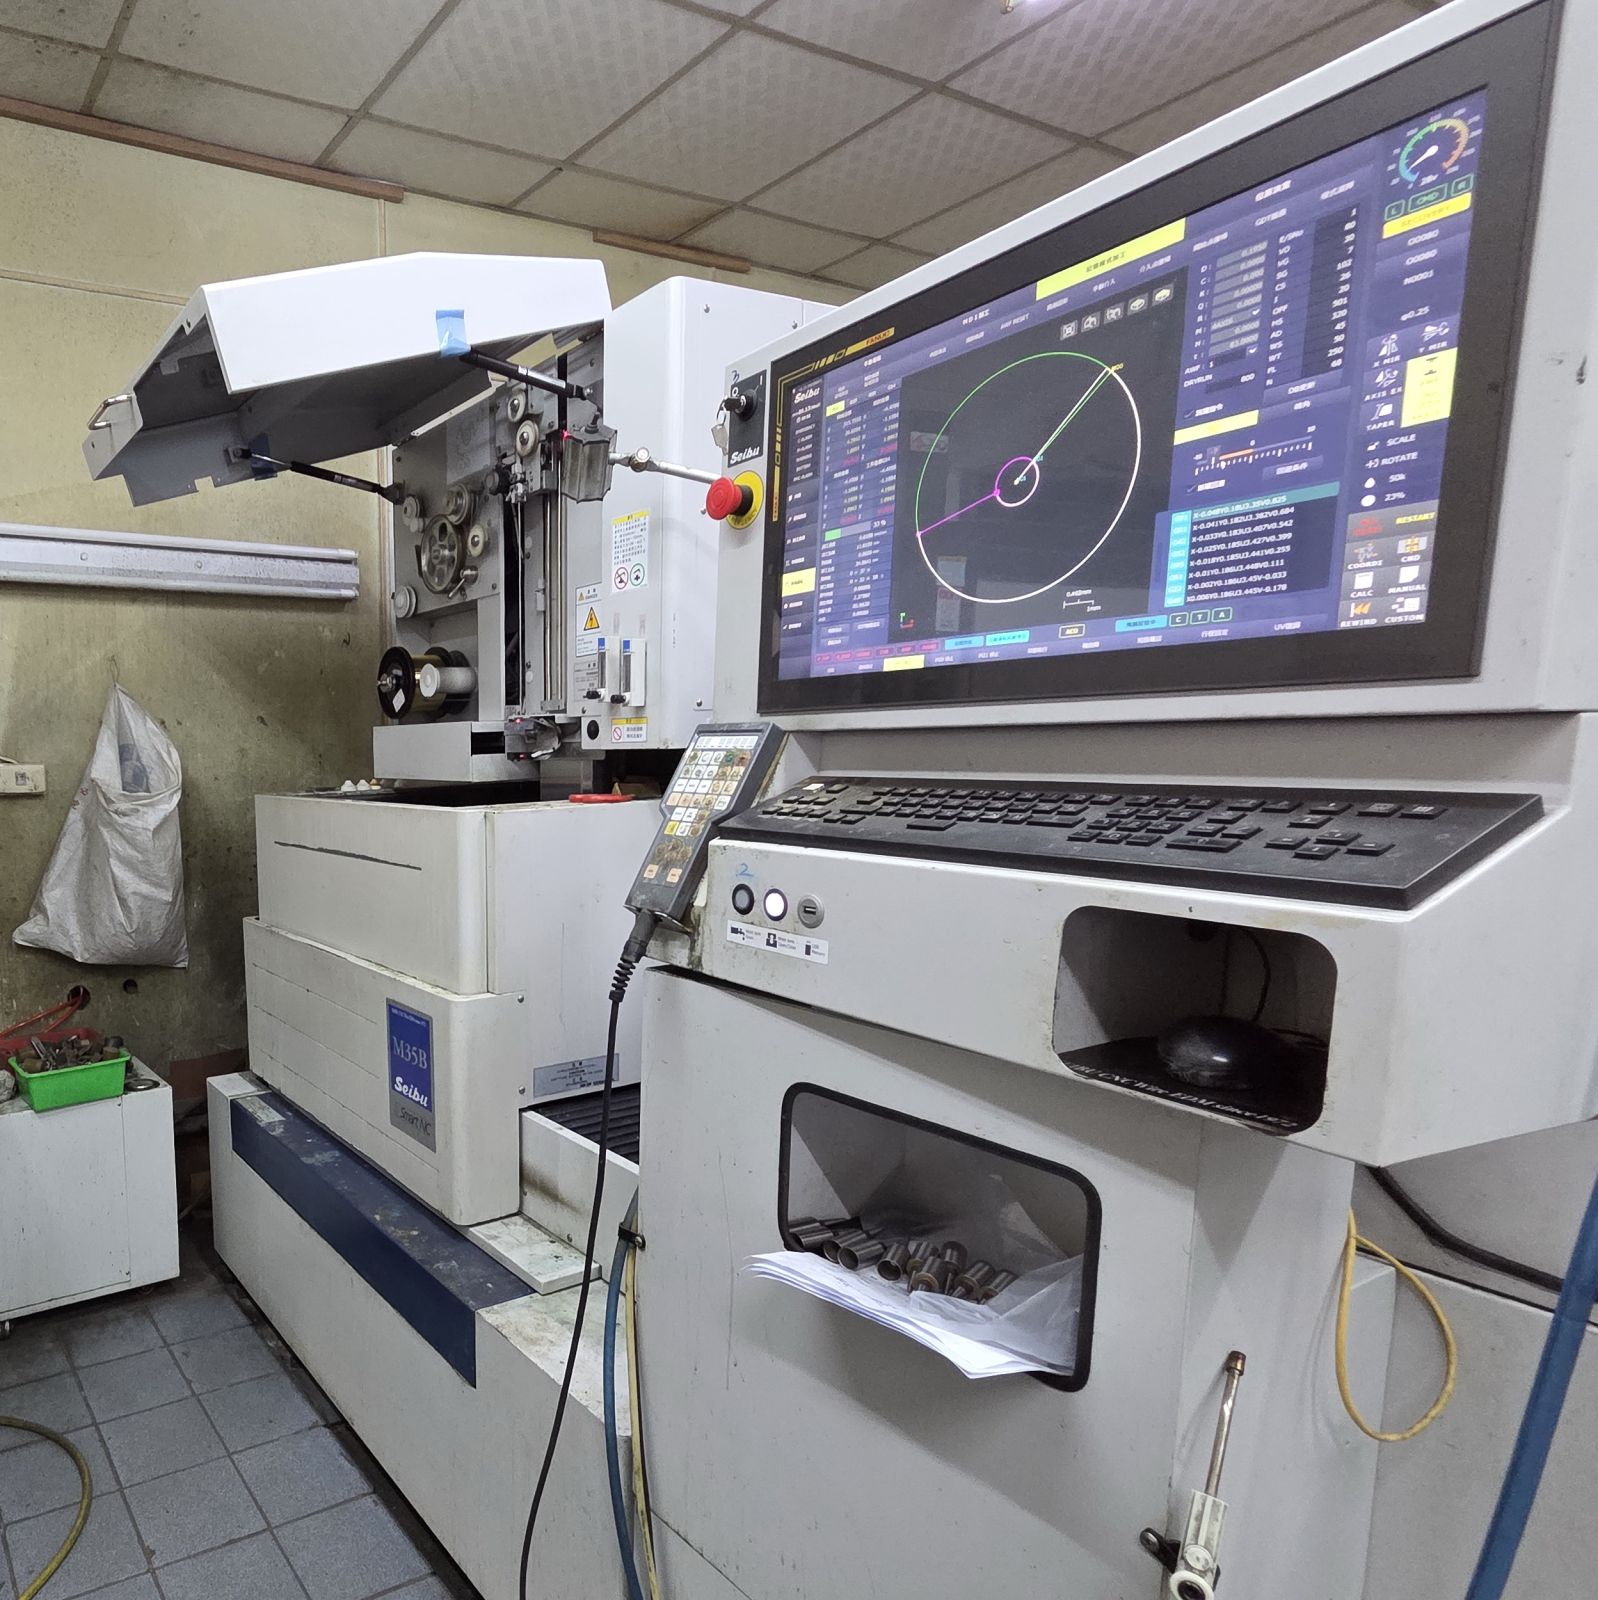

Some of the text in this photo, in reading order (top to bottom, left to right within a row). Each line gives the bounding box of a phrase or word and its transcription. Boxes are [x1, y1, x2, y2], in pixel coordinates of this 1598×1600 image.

[1365, 390, 1387, 401] AXIS
[1367, 420, 1395, 431] TAPER
[1386, 434, 1416, 446] SCALE
[730, 446, 760, 465] Seibu
[1381, 452, 1418, 465] ROTATE
[1396, 512, 1436, 524] RESTART
[1350, 590, 1374, 598] CALC
[1388, 584, 1426, 594] MANUAL
[1341, 618, 1377, 628] REWIND
[1385, 614, 1424, 623] CUSTOM
[736, 863, 754, 877] 2
[393, 1036, 428, 1070] M35B
[394, 1076, 428, 1107] Seibu
[400, 1107, 432, 1136] Smart NC
